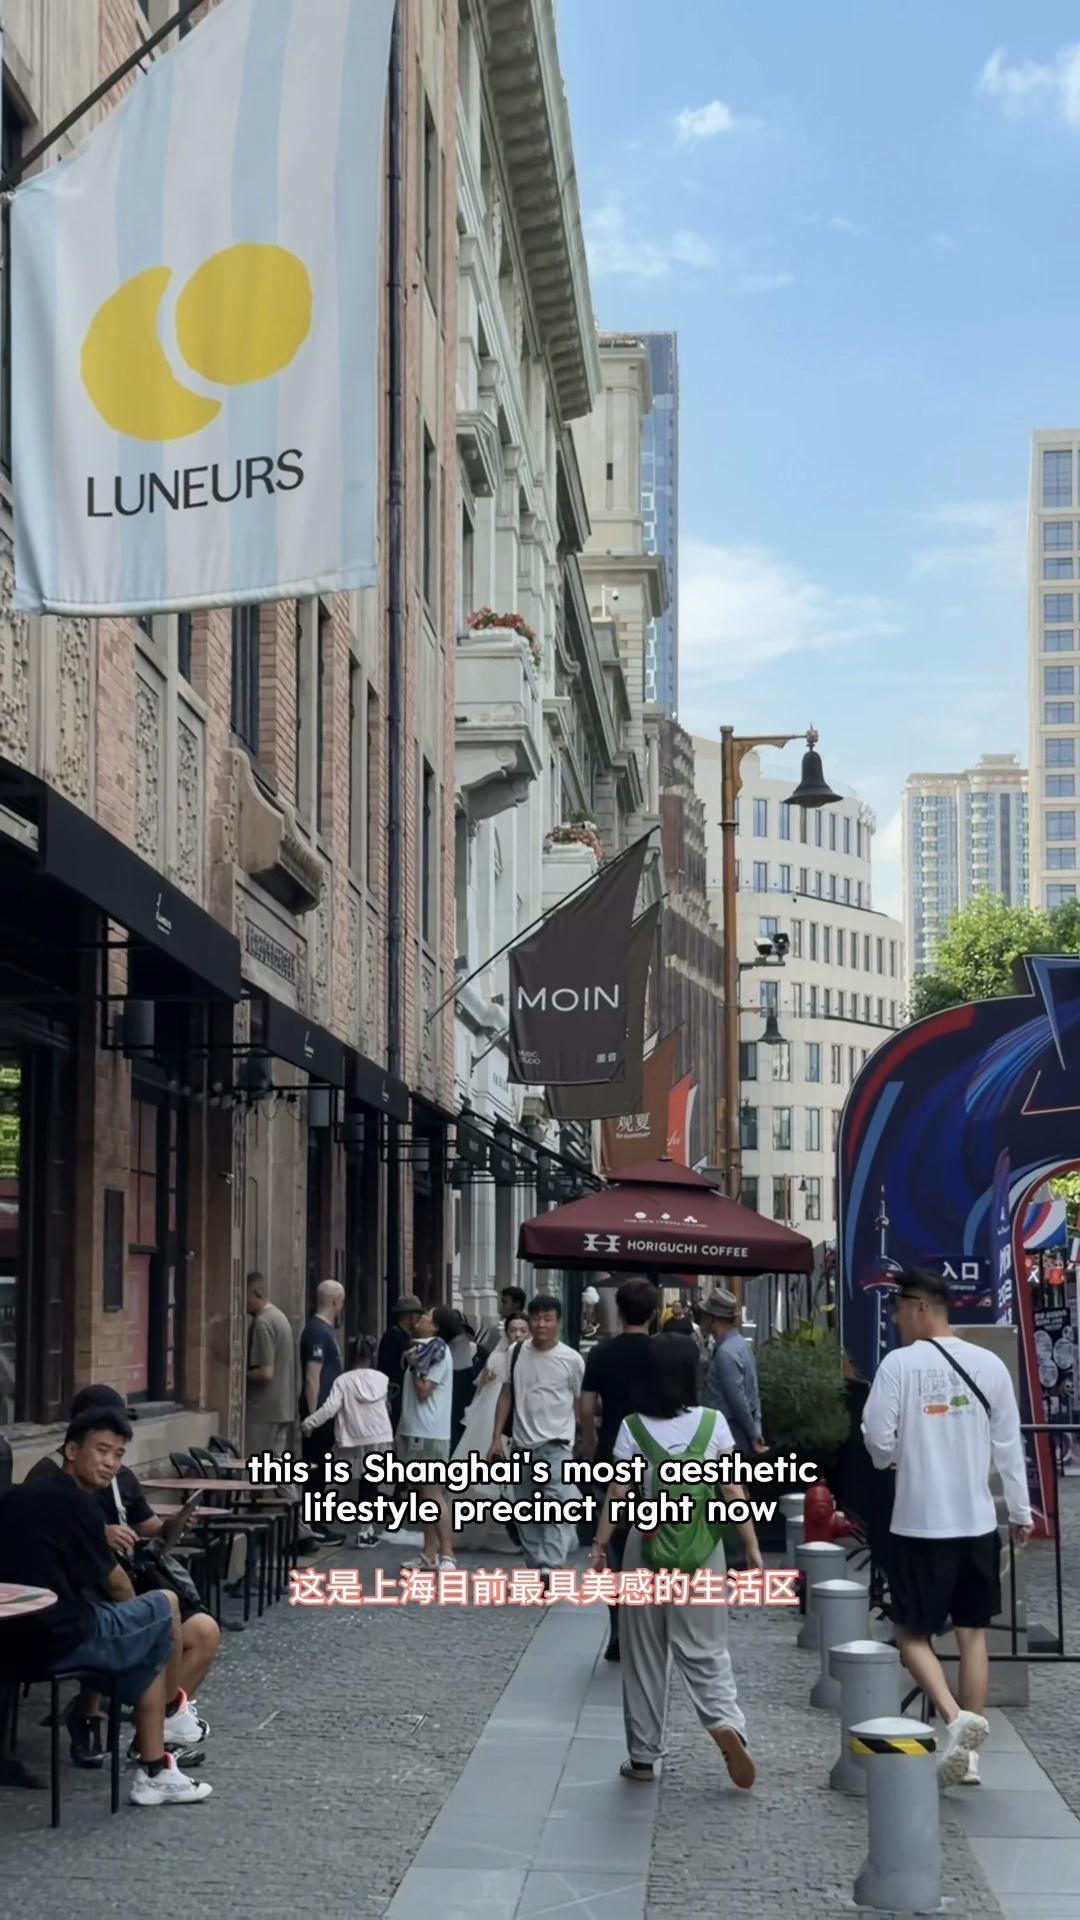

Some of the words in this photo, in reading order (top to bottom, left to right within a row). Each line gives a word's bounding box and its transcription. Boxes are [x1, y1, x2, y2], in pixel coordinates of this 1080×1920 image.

[86, 448, 305, 518] LUNEURS
[517, 983, 620, 1012] MOIN
[627, 1239, 698, 1255] HORIGUCHI
[701, 1245, 749, 1258] COFFEE
[942, 1261, 979, 1280] 入口
